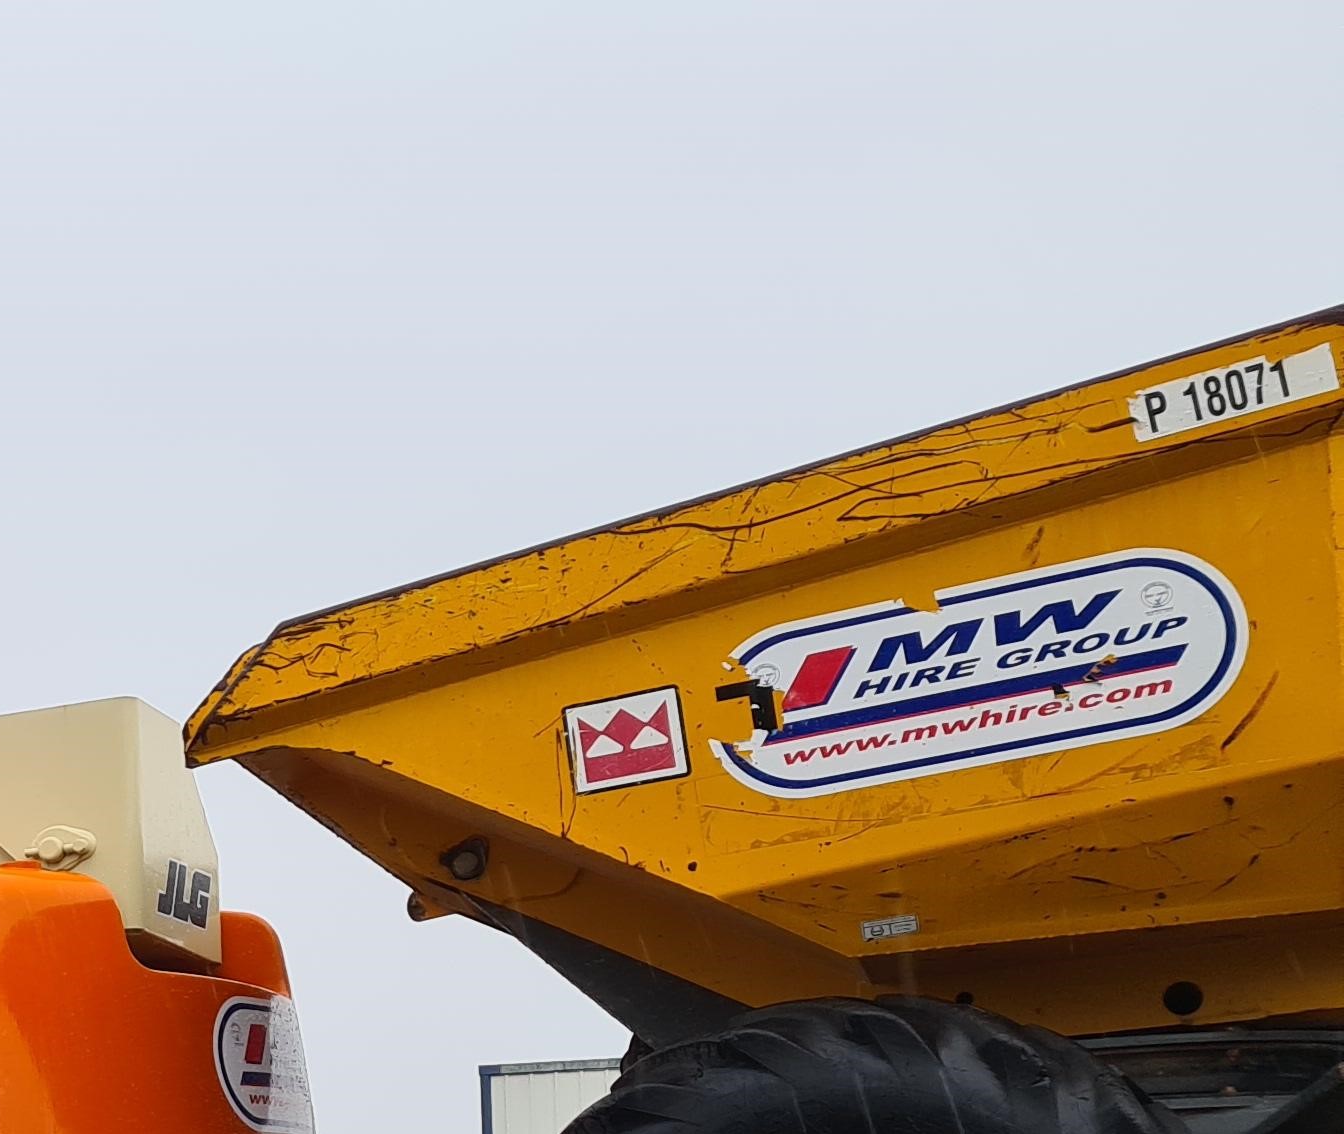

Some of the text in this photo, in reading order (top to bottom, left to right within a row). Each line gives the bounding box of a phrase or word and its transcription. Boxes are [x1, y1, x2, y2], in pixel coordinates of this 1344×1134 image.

[1144, 359, 1290, 433] P 18071
[853, 615, 1189, 699] HIRE GROUP
[866, 588, 1123, 674] MW
[783, 678, 1174, 766] www.mwhire.com
[155, 858, 212, 930] JLG
